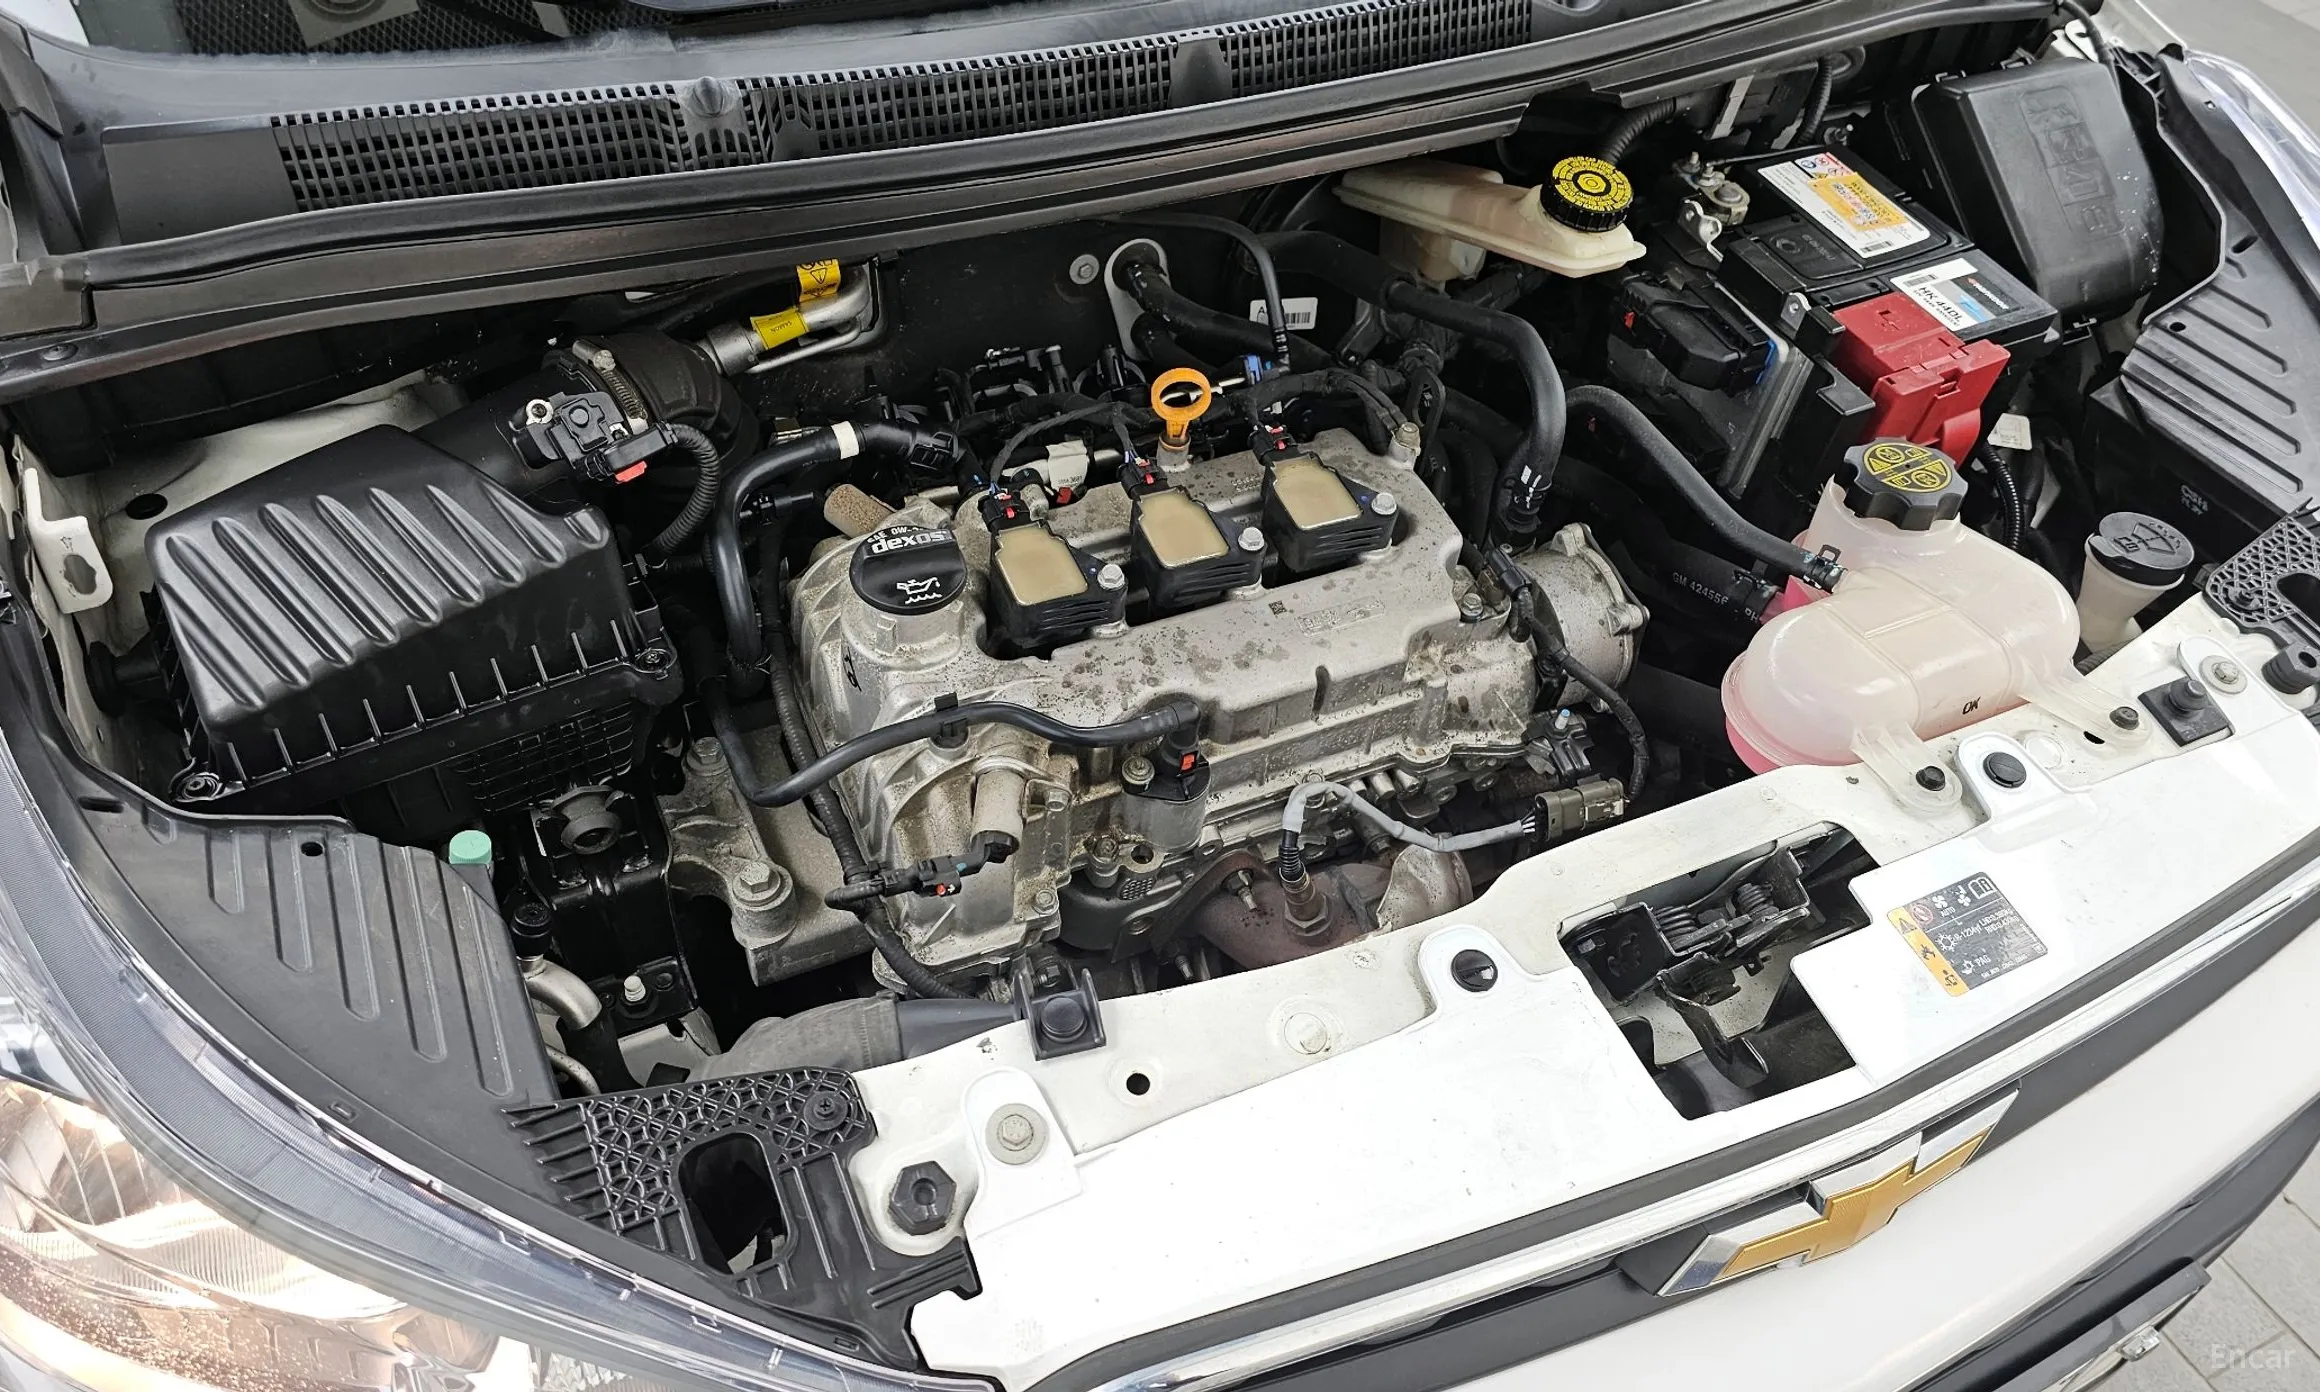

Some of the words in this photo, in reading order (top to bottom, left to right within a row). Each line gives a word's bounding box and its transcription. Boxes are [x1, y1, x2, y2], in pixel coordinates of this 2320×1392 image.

[867, 530, 888, 543] SAE
[891, 526, 923, 535] 0W-
[1672, 572, 1687, 586] GM
[1962, 696, 1981, 715] OK
[1974, 954, 1991, 967] PAG
